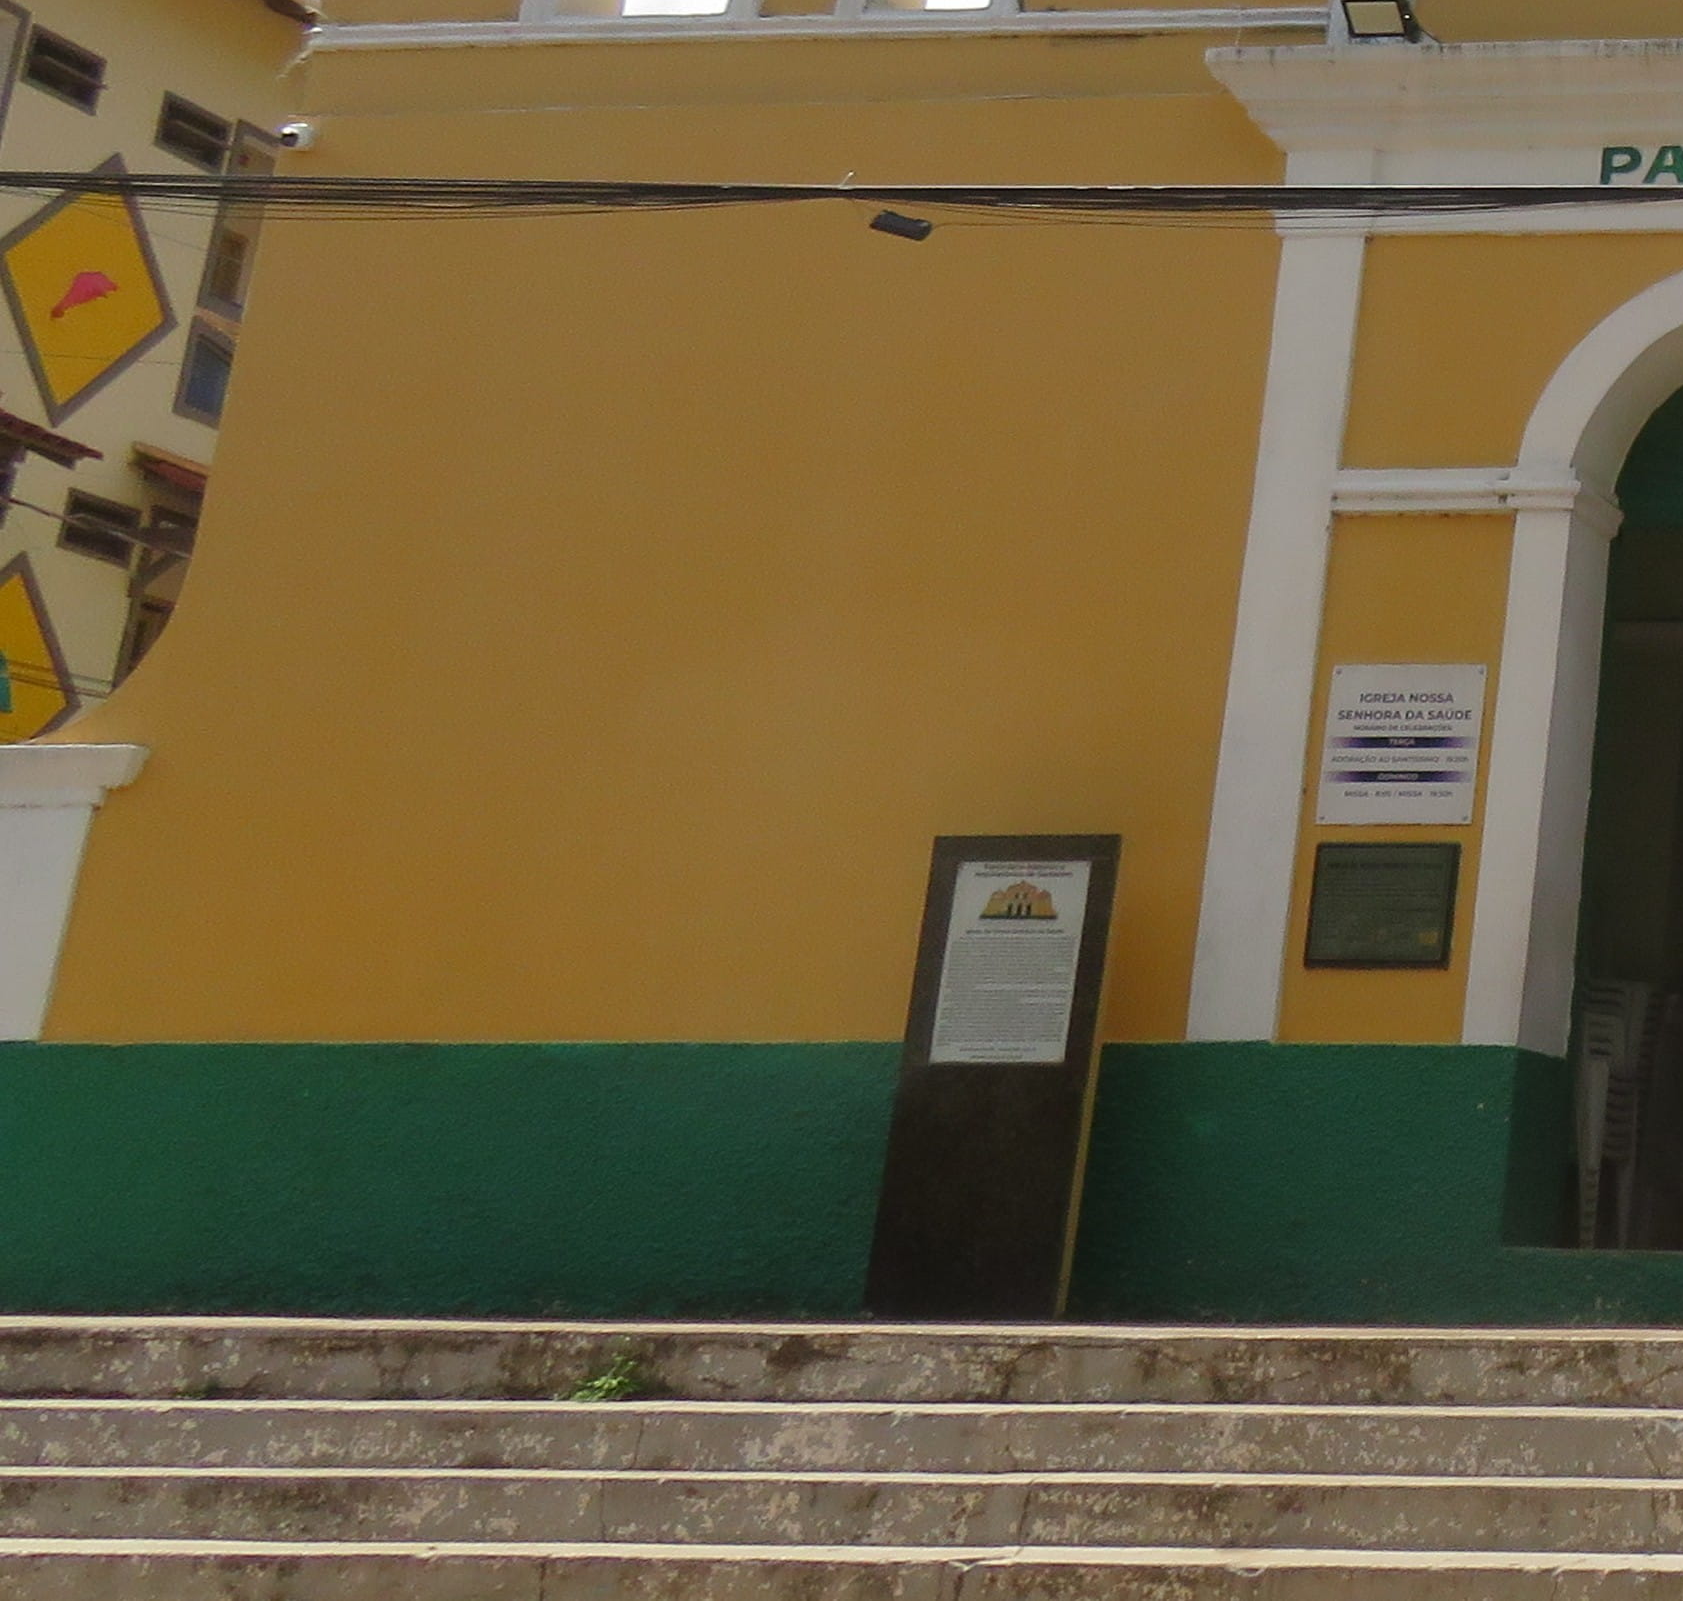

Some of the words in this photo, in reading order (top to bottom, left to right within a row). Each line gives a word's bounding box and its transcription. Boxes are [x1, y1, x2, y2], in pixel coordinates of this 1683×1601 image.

[1360, 693, 1405, 704] IGREJA
[1409, 692, 1454, 703] NOSSA
[1338, 709, 1402, 721] SENHORA
[1405, 709, 1424, 720] DA
